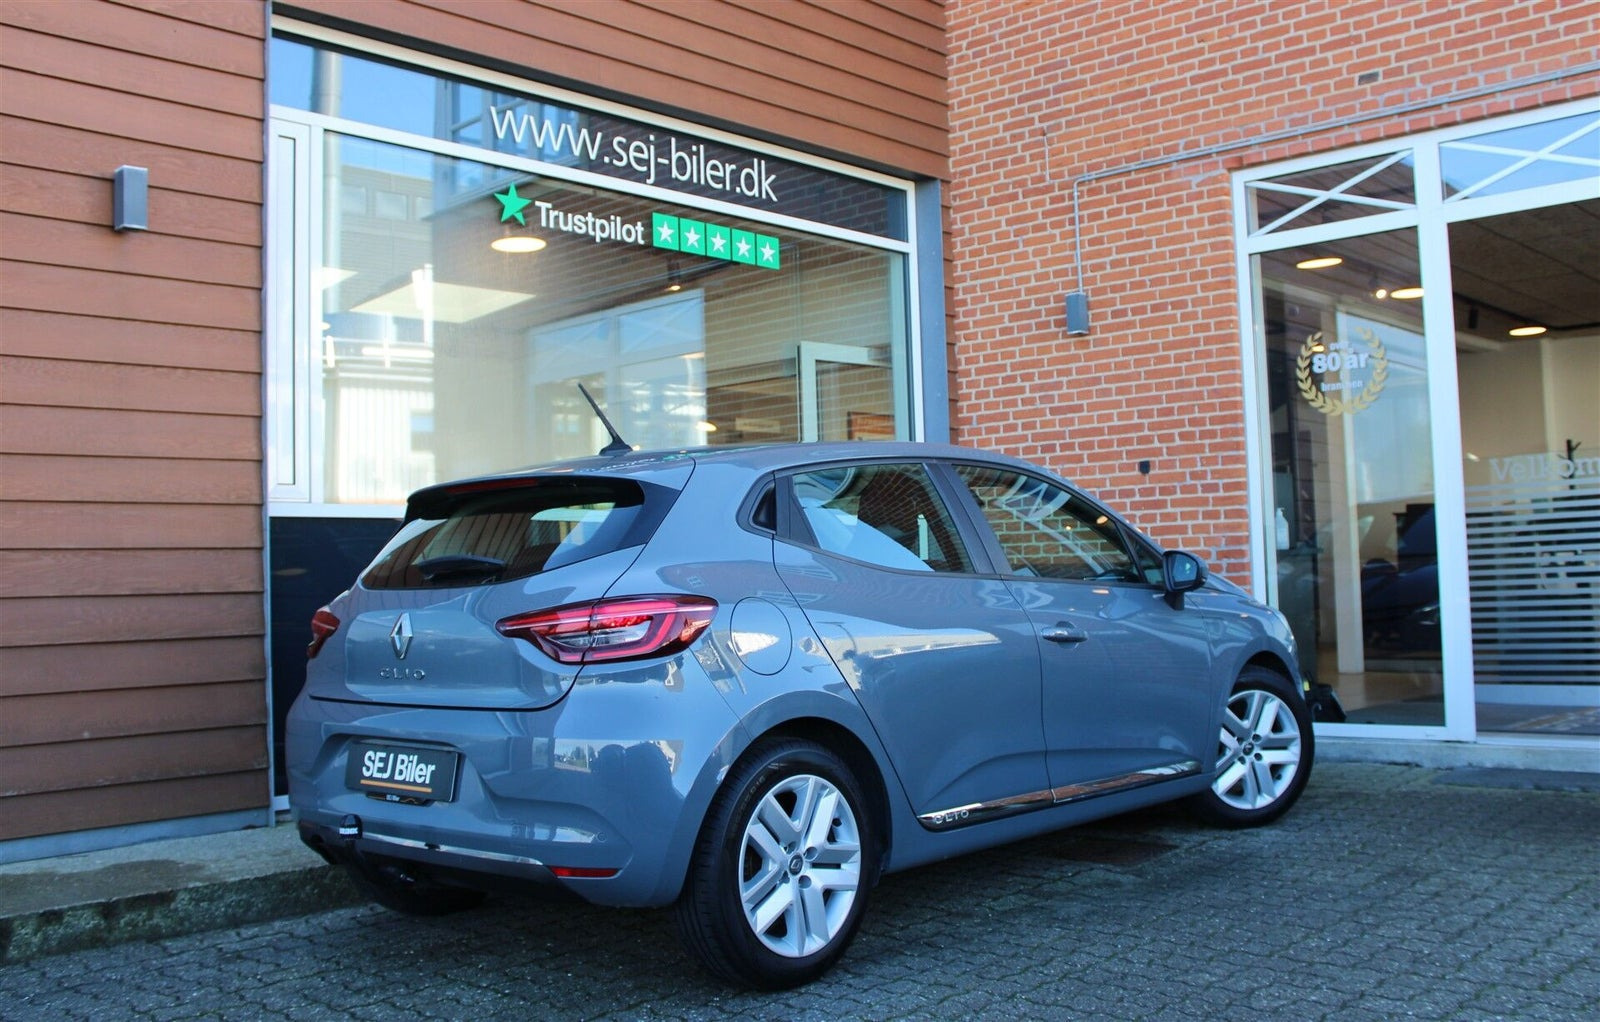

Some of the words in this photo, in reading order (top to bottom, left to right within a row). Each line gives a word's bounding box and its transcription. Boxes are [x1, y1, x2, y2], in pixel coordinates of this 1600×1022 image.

[490, 105, 778, 202] www.sej-biler.dk
[535, 201, 645, 245] Trustpilot
[1312, 352, 1341, 374] 80
[380, 667, 426, 681] CLIO
[362, 750, 395, 779] SEJ
[394, 753, 436, 784] Biler
[933, 809, 969, 825] CLIO
